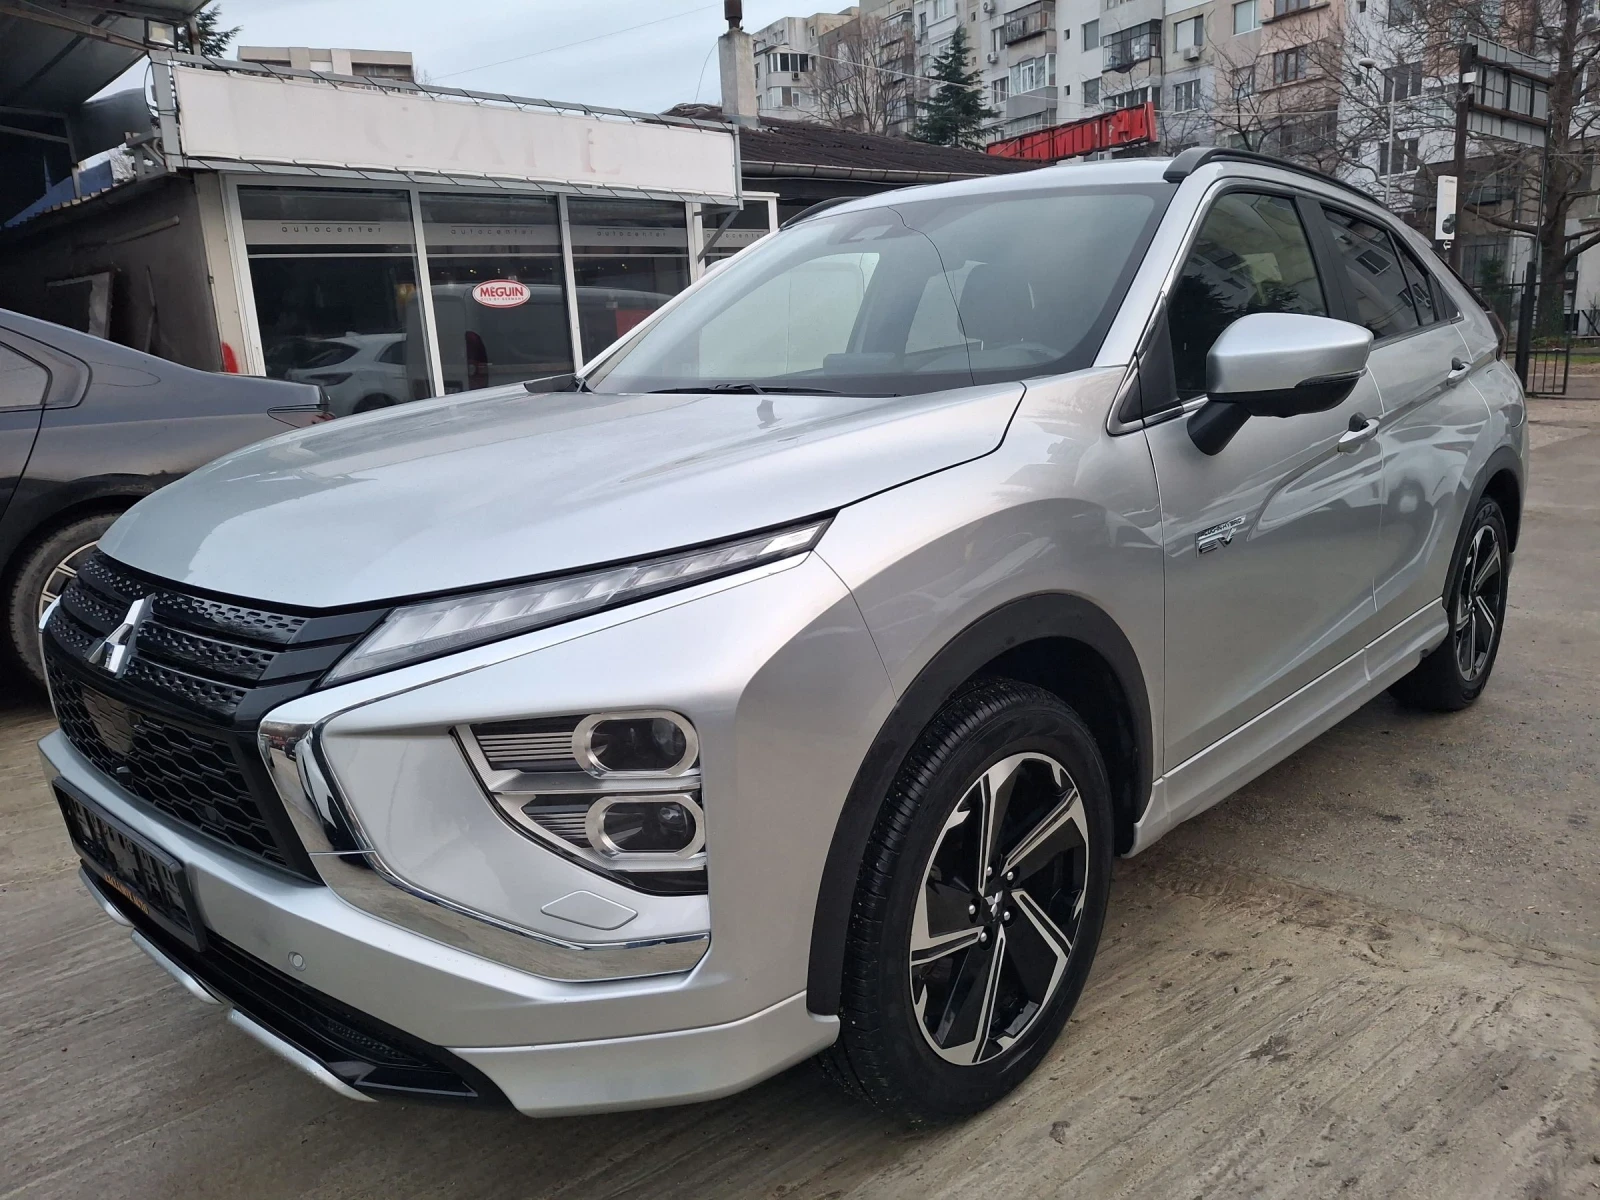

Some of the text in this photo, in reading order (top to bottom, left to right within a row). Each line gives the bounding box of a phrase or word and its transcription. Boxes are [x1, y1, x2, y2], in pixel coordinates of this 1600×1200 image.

[281, 225, 381, 233] autocenter
[450, 227, 533, 235] autocenter
[1198, 528, 1237, 554] EV
